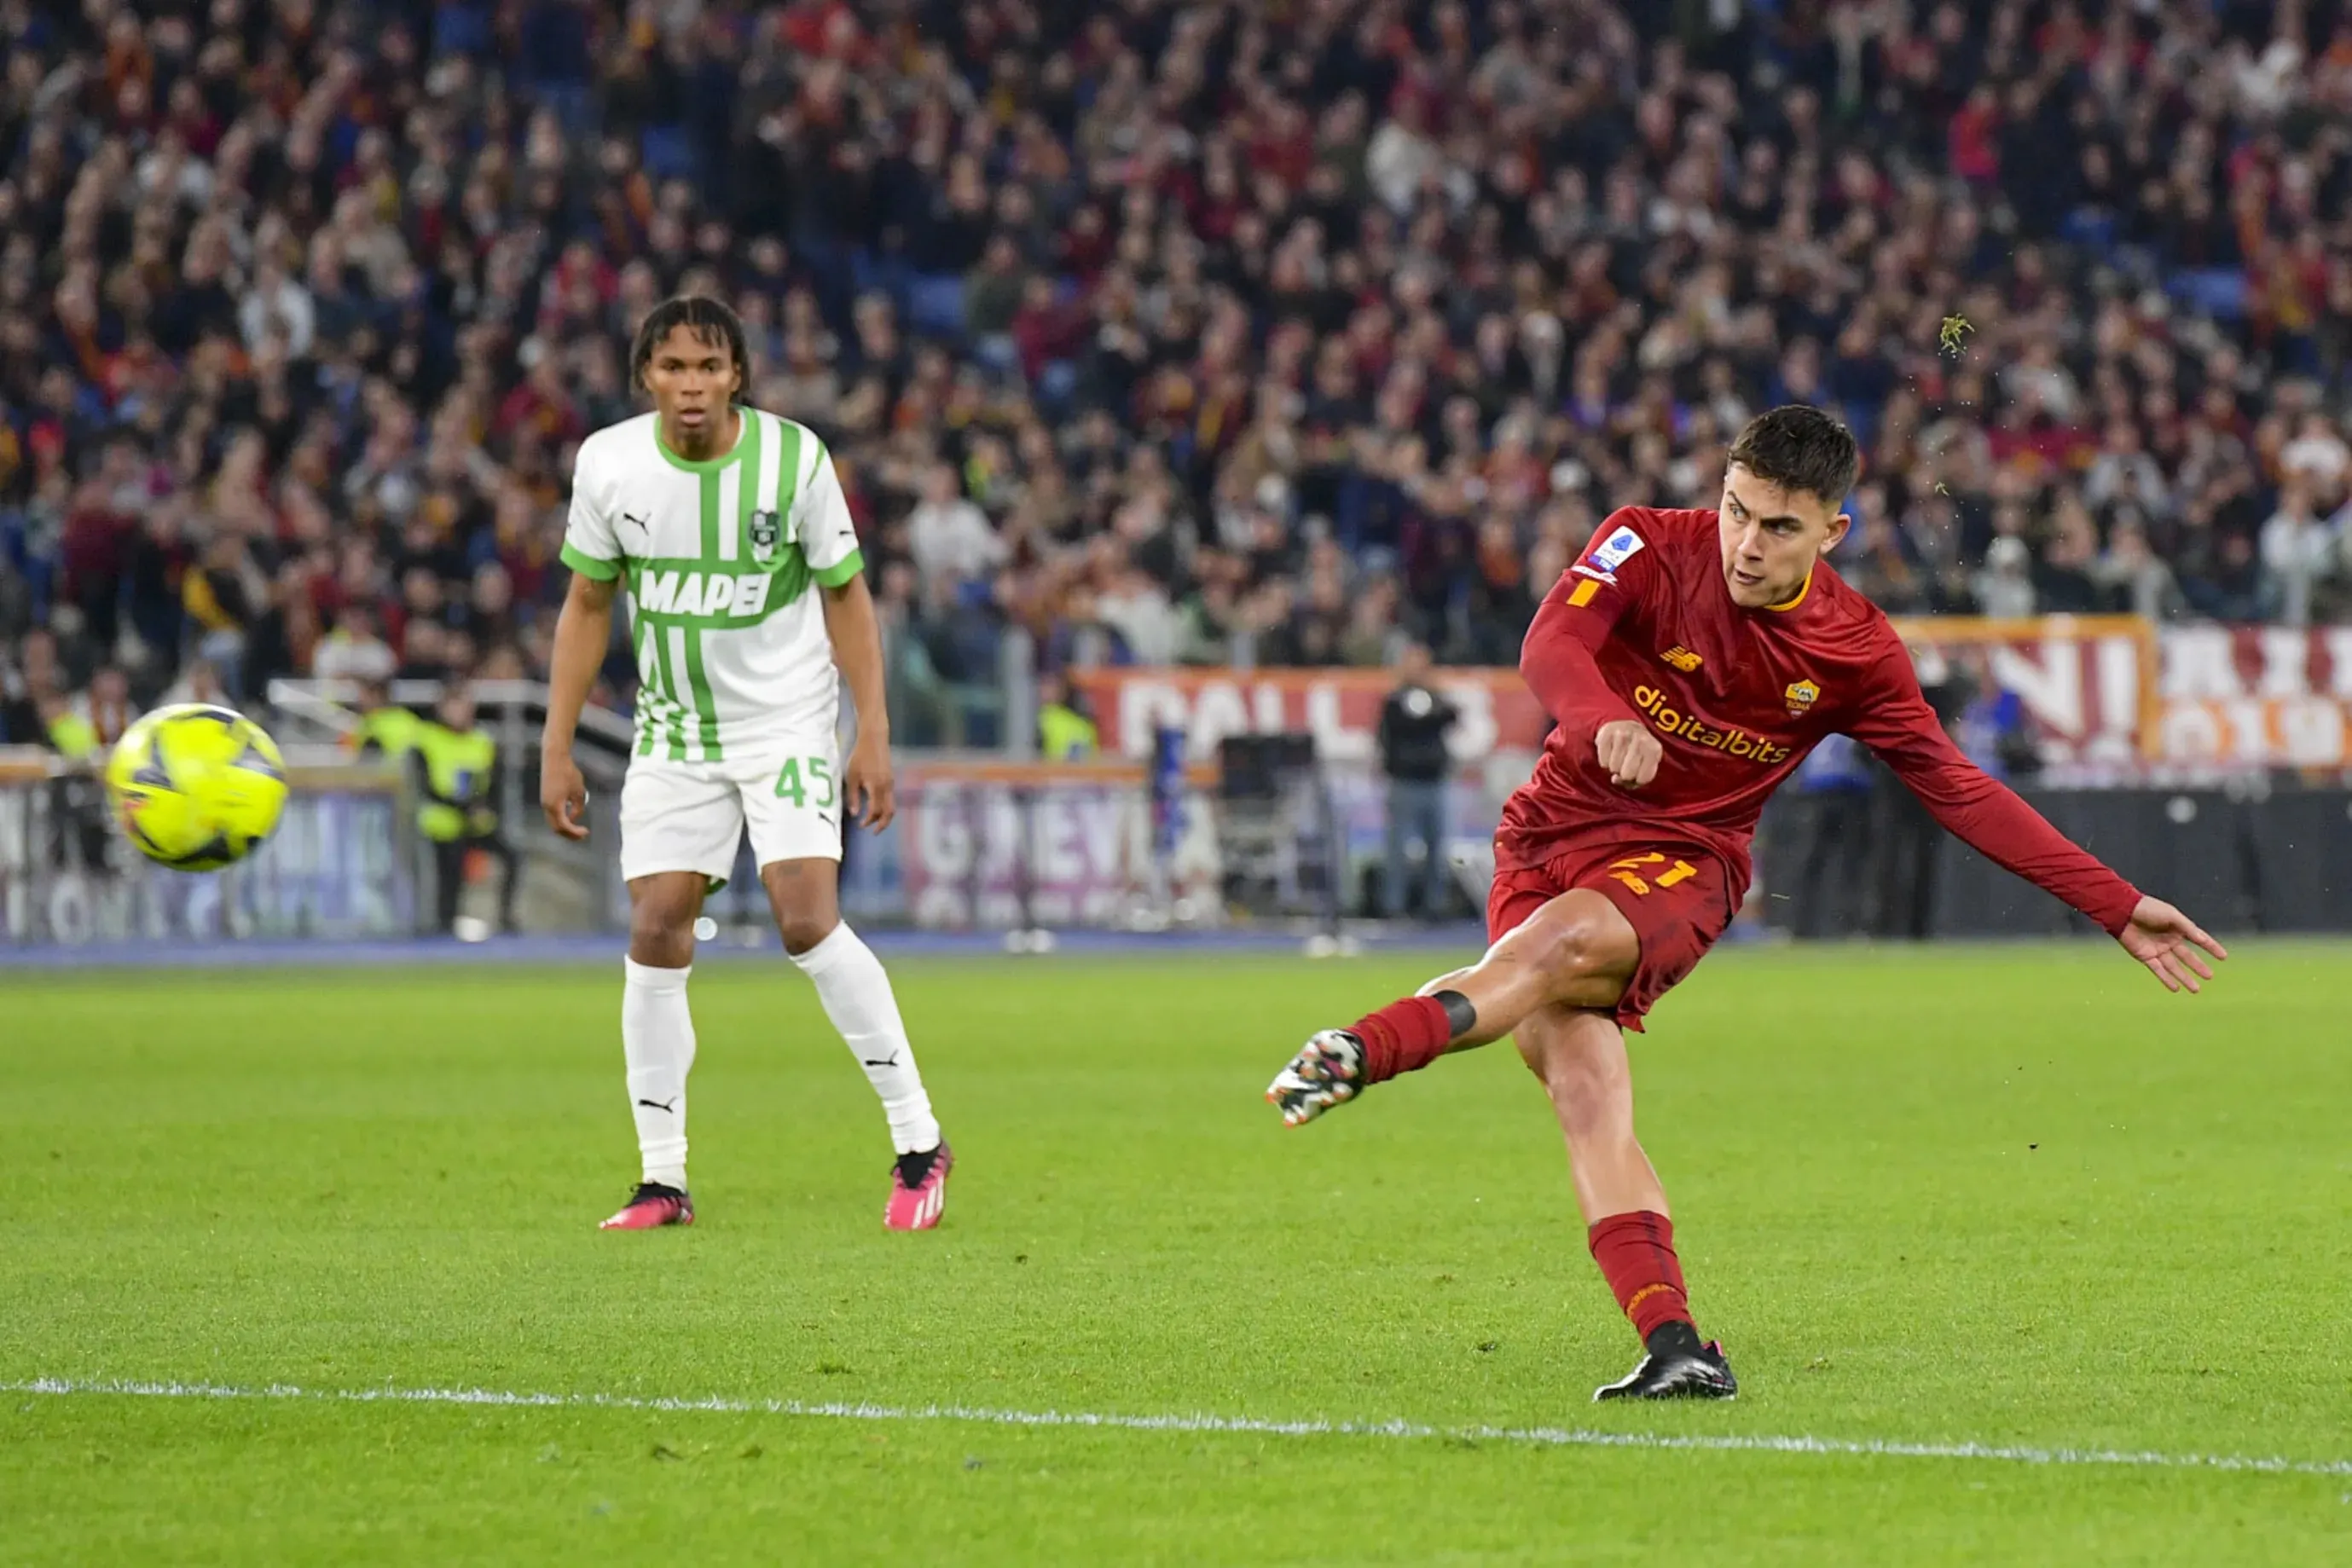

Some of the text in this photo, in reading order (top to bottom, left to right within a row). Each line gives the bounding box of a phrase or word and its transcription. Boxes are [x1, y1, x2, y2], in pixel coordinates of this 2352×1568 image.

[640, 570, 772, 617] MAPEI
[1634, 685, 1790, 763] digitalbits
[774, 755, 834, 808] 45
